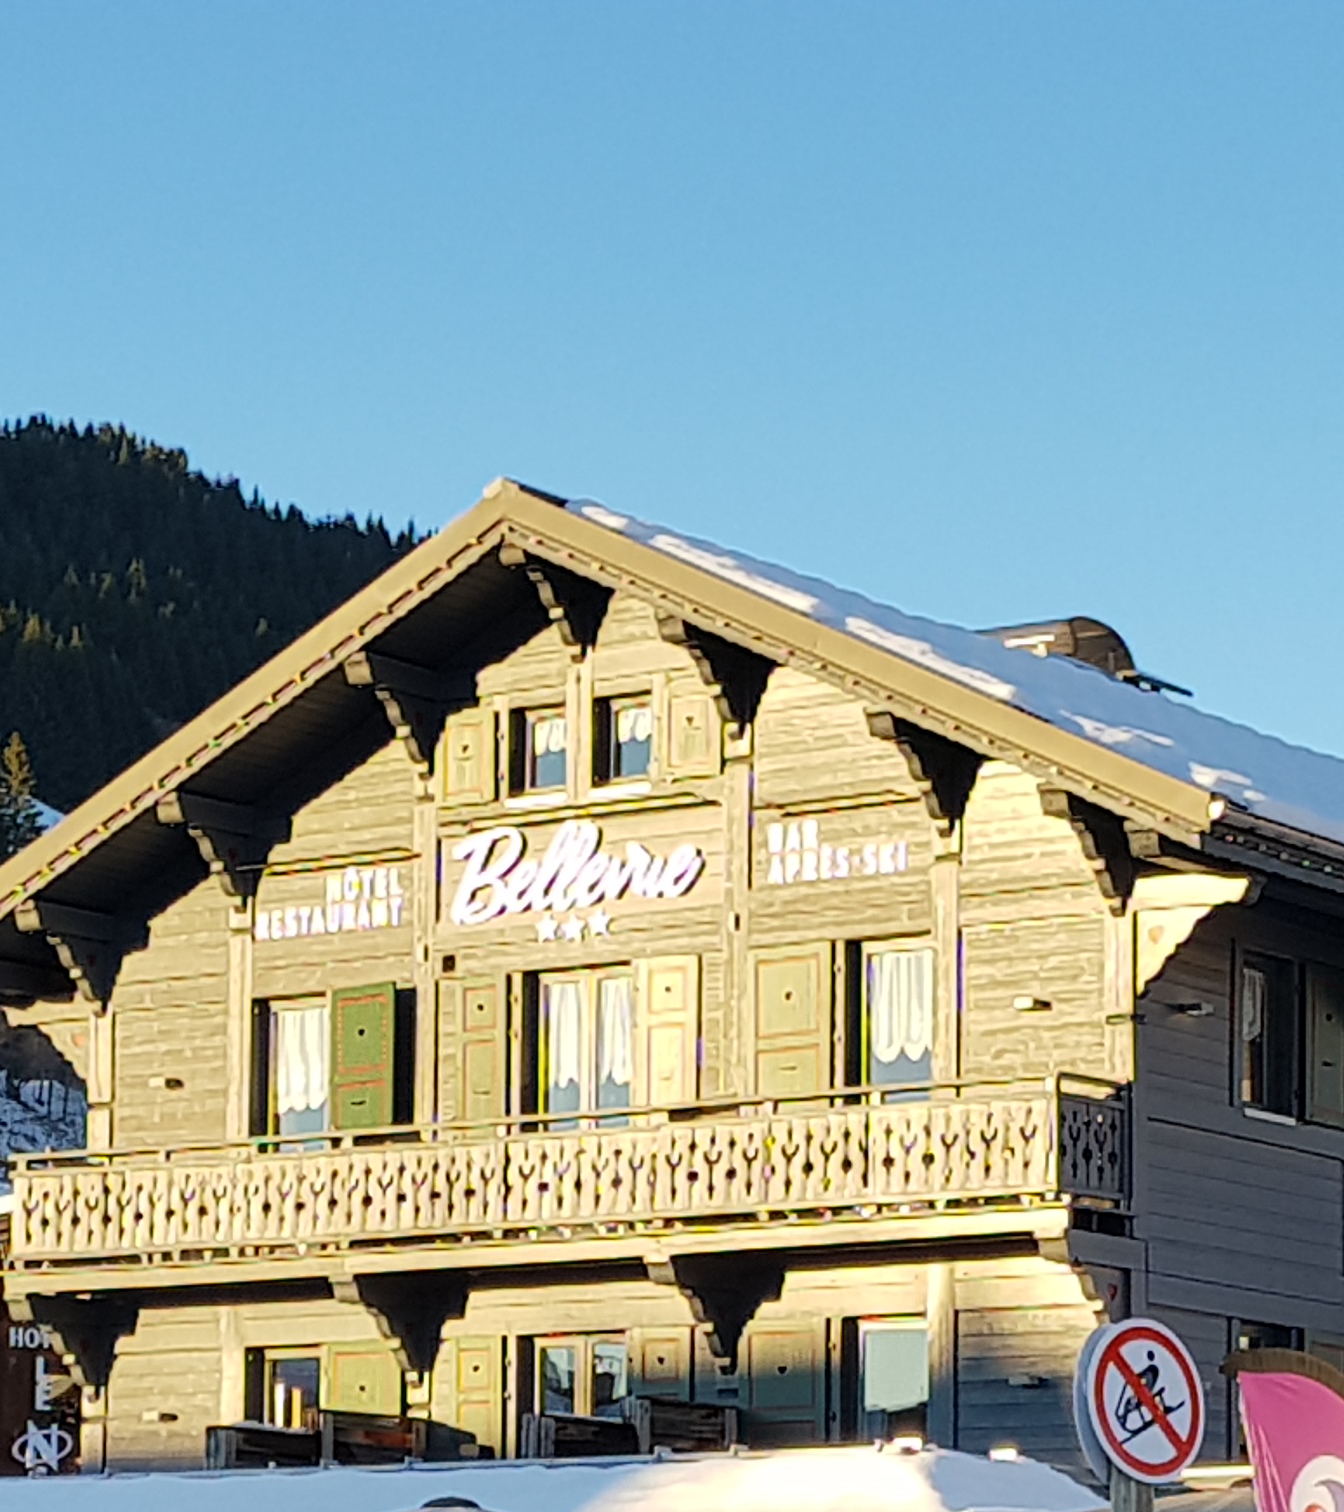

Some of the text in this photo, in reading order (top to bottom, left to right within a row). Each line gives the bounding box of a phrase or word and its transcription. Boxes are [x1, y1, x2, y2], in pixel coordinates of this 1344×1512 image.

[767, 819, 819, 853] BAR
[325, 866, 403, 902] HÔTEL
[453, 819, 704, 925] Bellevue
[255, 897, 402, 941] RESTAURANT
[9, 1326, 52, 1349] HOT
